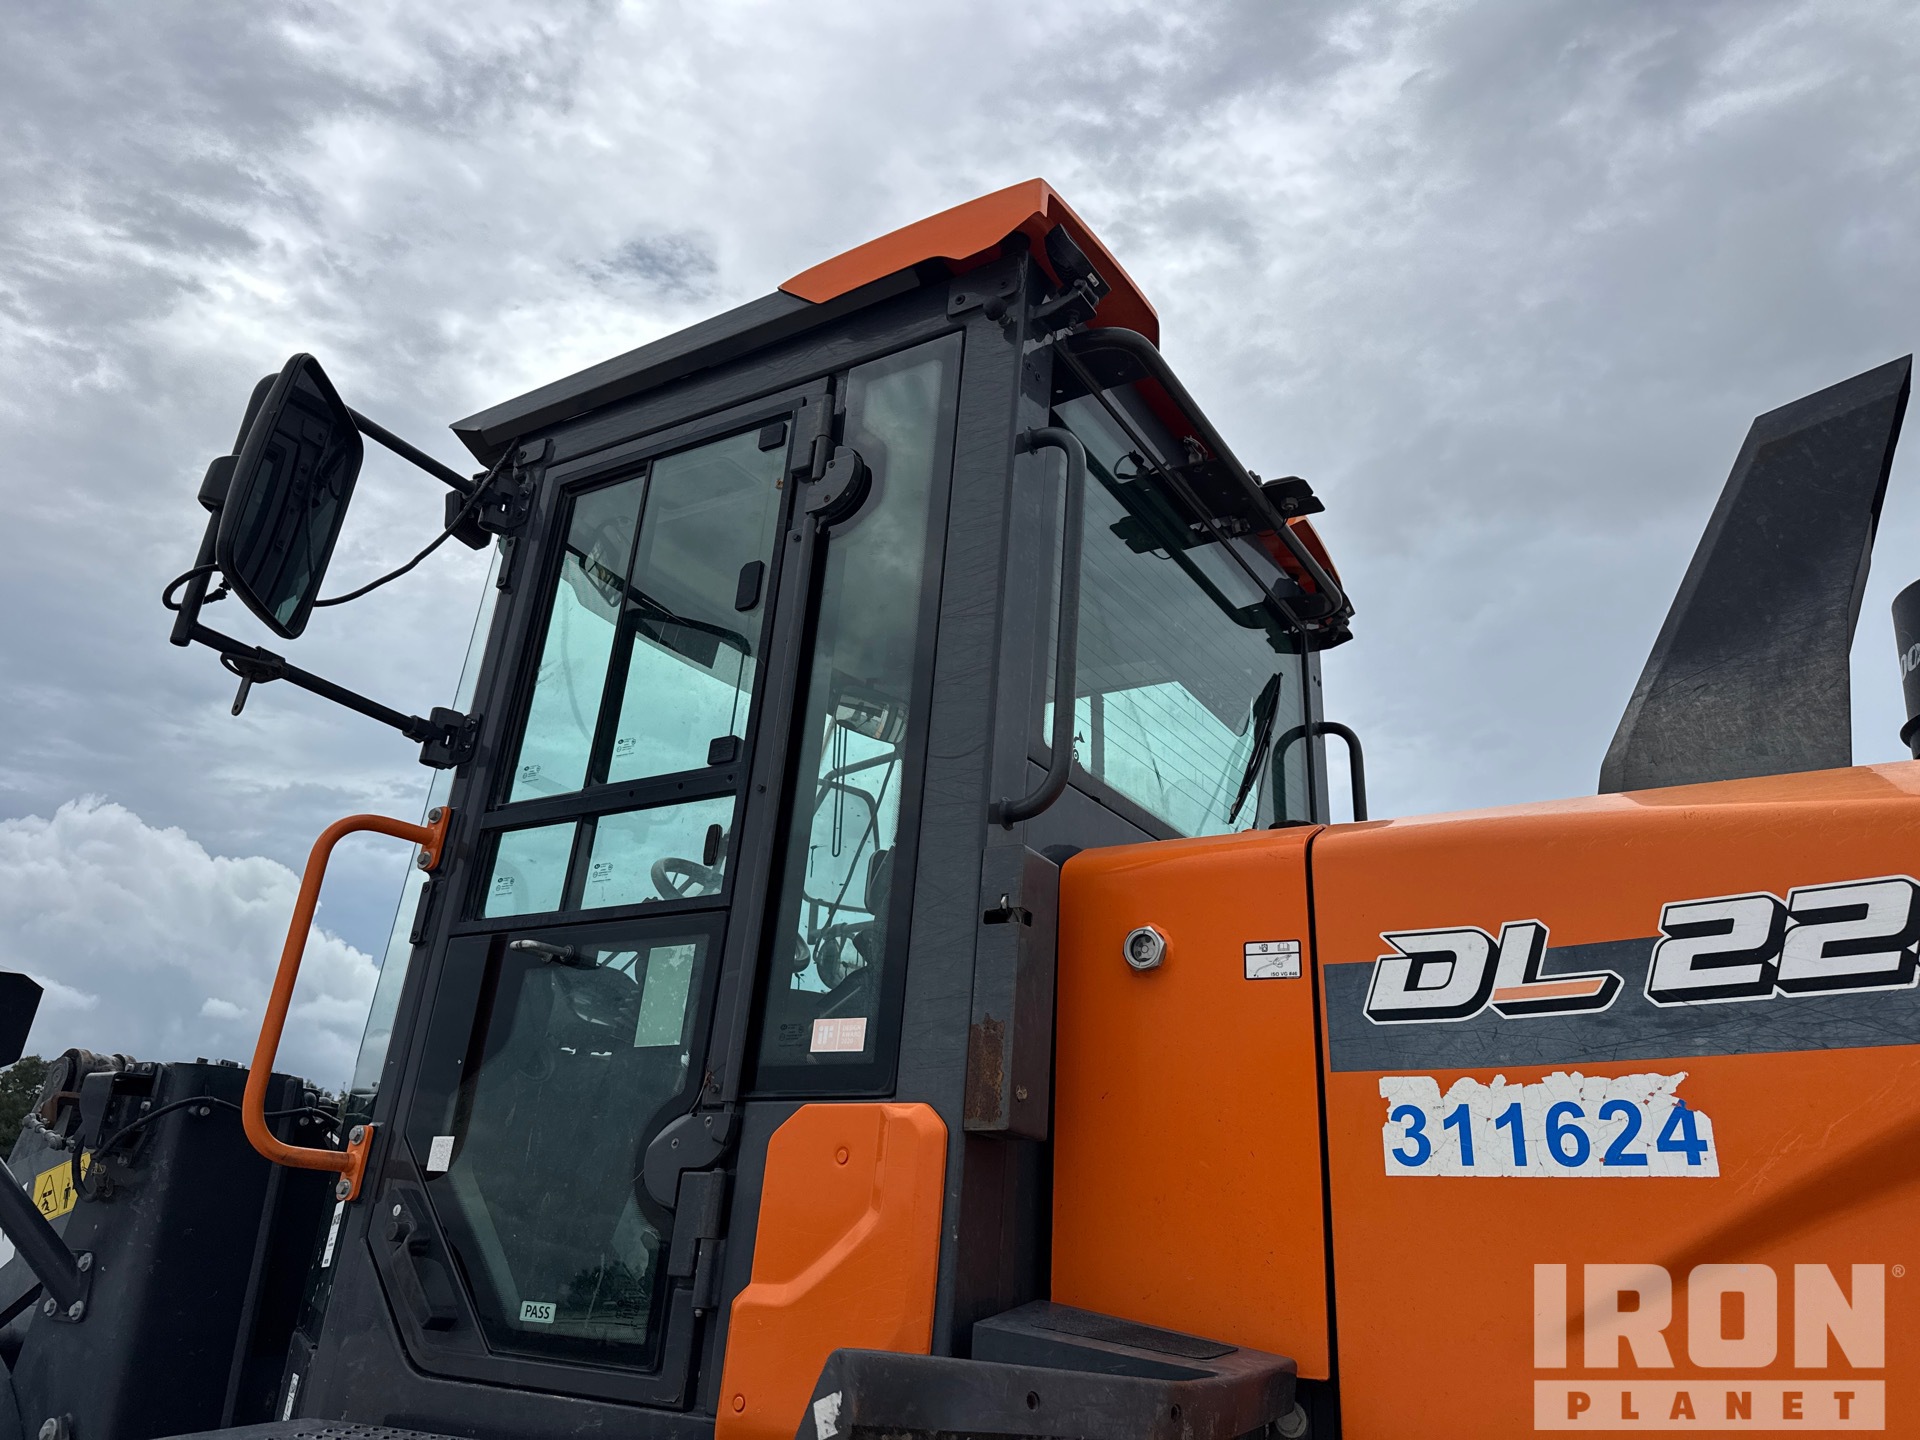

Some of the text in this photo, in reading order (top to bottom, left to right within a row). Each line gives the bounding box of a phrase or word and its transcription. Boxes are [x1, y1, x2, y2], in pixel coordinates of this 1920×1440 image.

[1363, 874, 1920, 1025] DL 22
[1390, 1099, 1708, 1167] 311624
[524, 1305, 550, 1319] PASS
